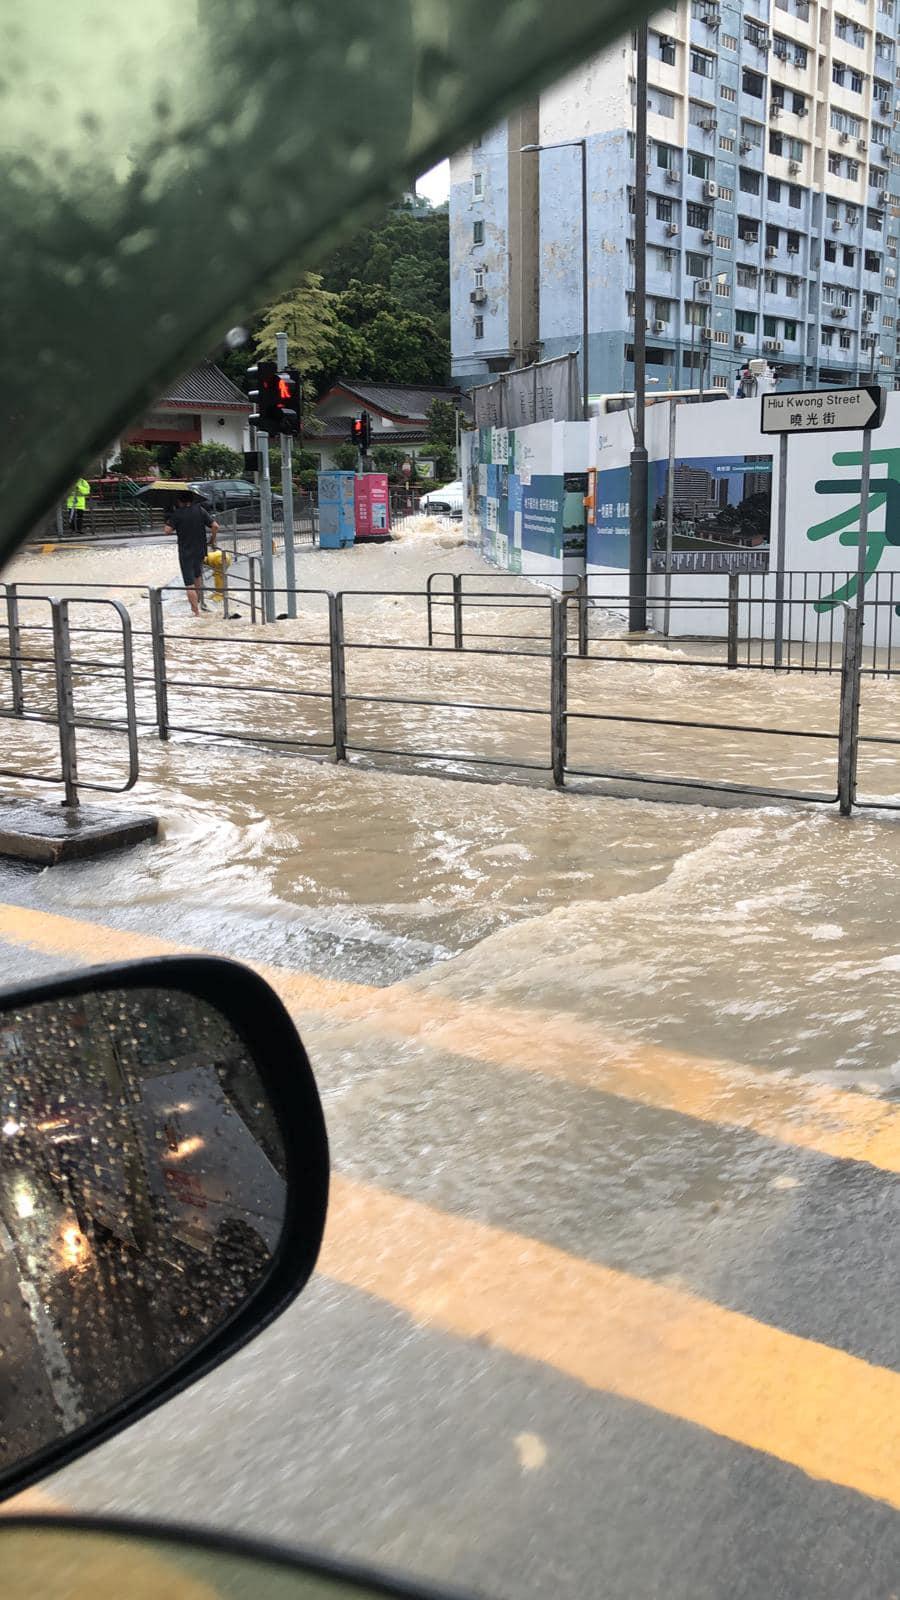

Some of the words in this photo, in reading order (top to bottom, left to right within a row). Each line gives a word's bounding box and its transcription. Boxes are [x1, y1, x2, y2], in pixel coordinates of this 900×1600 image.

[768, 399, 784, 408] Hiu
[787, 397, 823, 408] Kwong
[826, 395, 860, 404] Street
[790, 412, 836, 426] 曉光街
